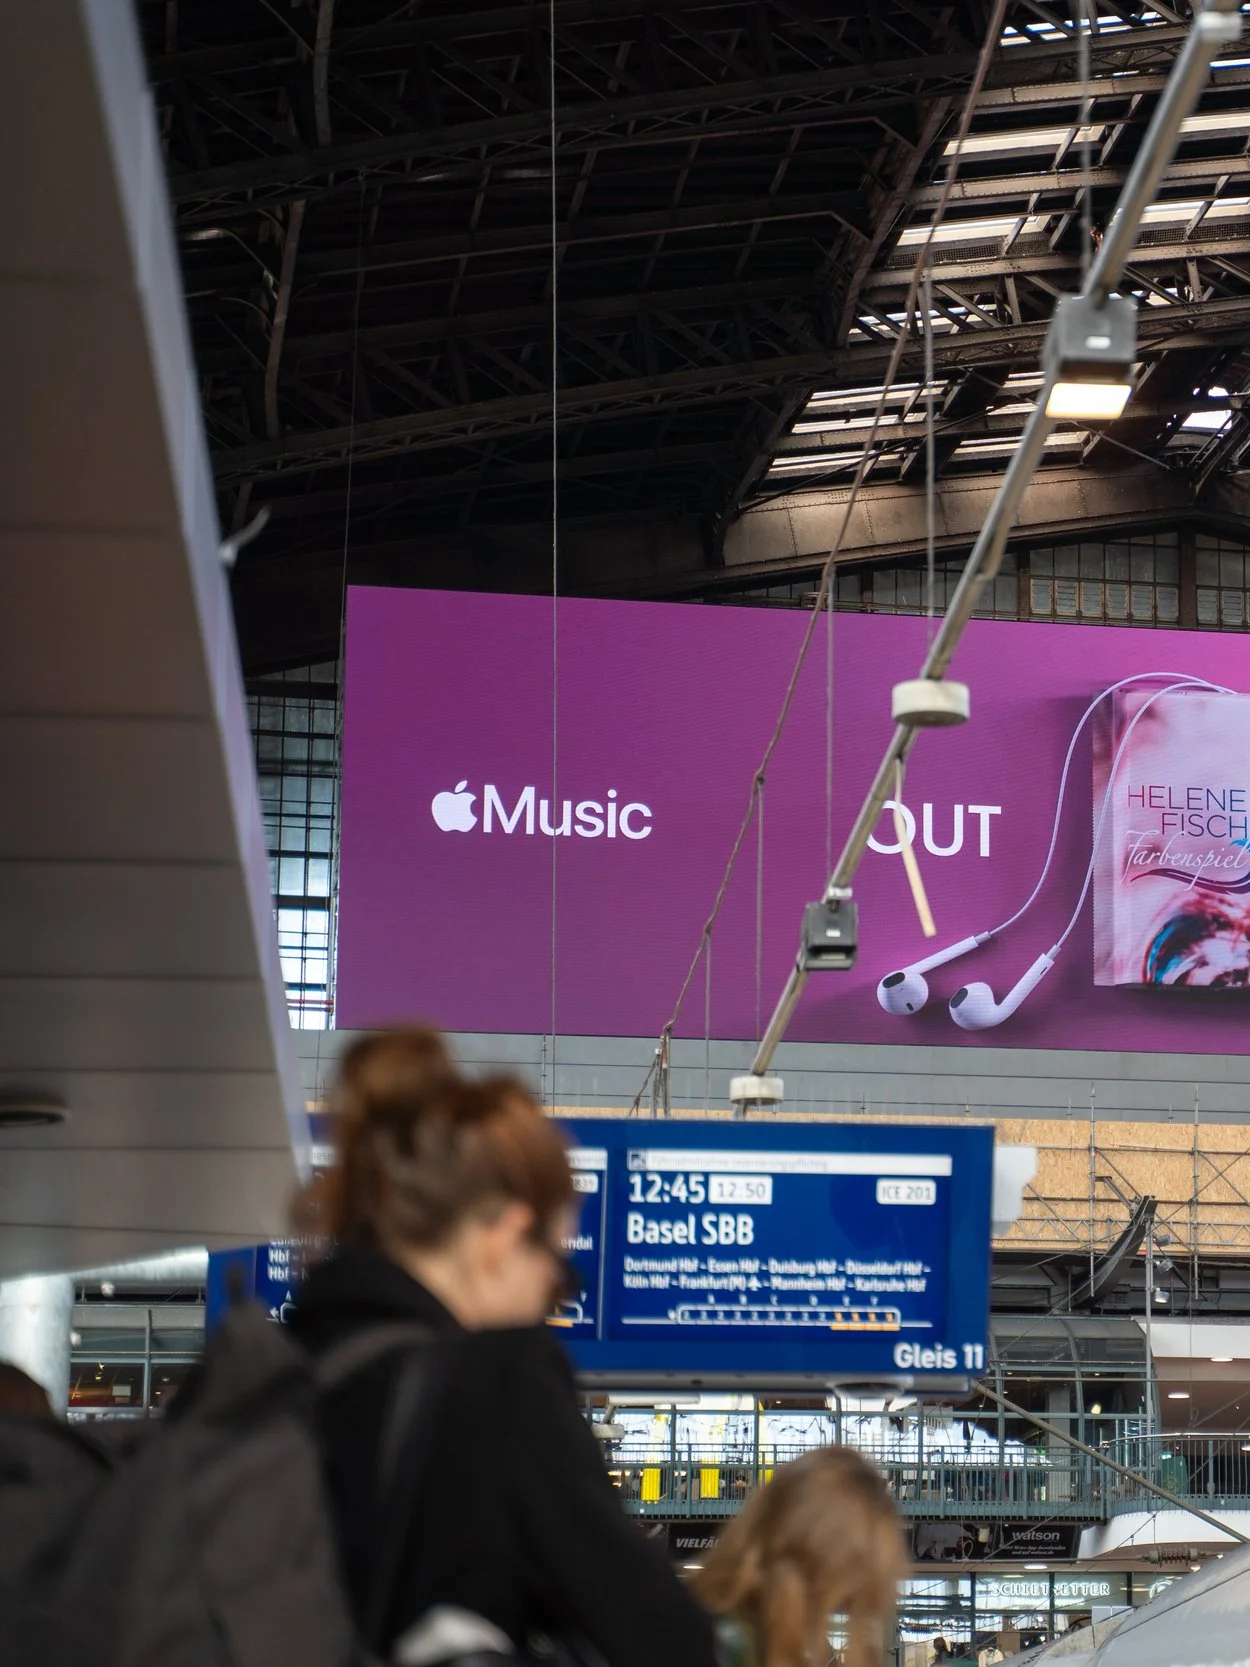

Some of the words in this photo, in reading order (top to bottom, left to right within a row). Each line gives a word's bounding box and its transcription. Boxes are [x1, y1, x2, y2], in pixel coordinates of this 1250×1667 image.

[483, 784, 652, 839] Music
[1128, 785, 1246, 812] HELENE
[866, 800, 1002, 857] OUT
[629, 1172, 705, 1203] 12:45
[717, 1183, 766, 1198] 12:50
[881, 1186, 902, 1200] ICE
[906, 1186, 931, 1200] 201
[627, 1211, 697, 1245] Basel
[701, 1212, 755, 1246] SBB
[268, 1266, 290, 1281] Hbf
[624, 1256, 677, 1273] Dortmund
[707, 1256, 738, 1273] Essen
[768, 1257, 816, 1277] Duisburg
[845, 1258, 901, 1276] Düsseldorf
[623, 1272, 649, 1289] Köln
[770, 1275, 825, 1291] Mannheim
[854, 1276, 905, 1292] Karlsruhe
[894, 1342, 957, 1369] Gleis
[962, 1342, 983, 1369] 11
[1012, 1531, 1060, 1540] watson
